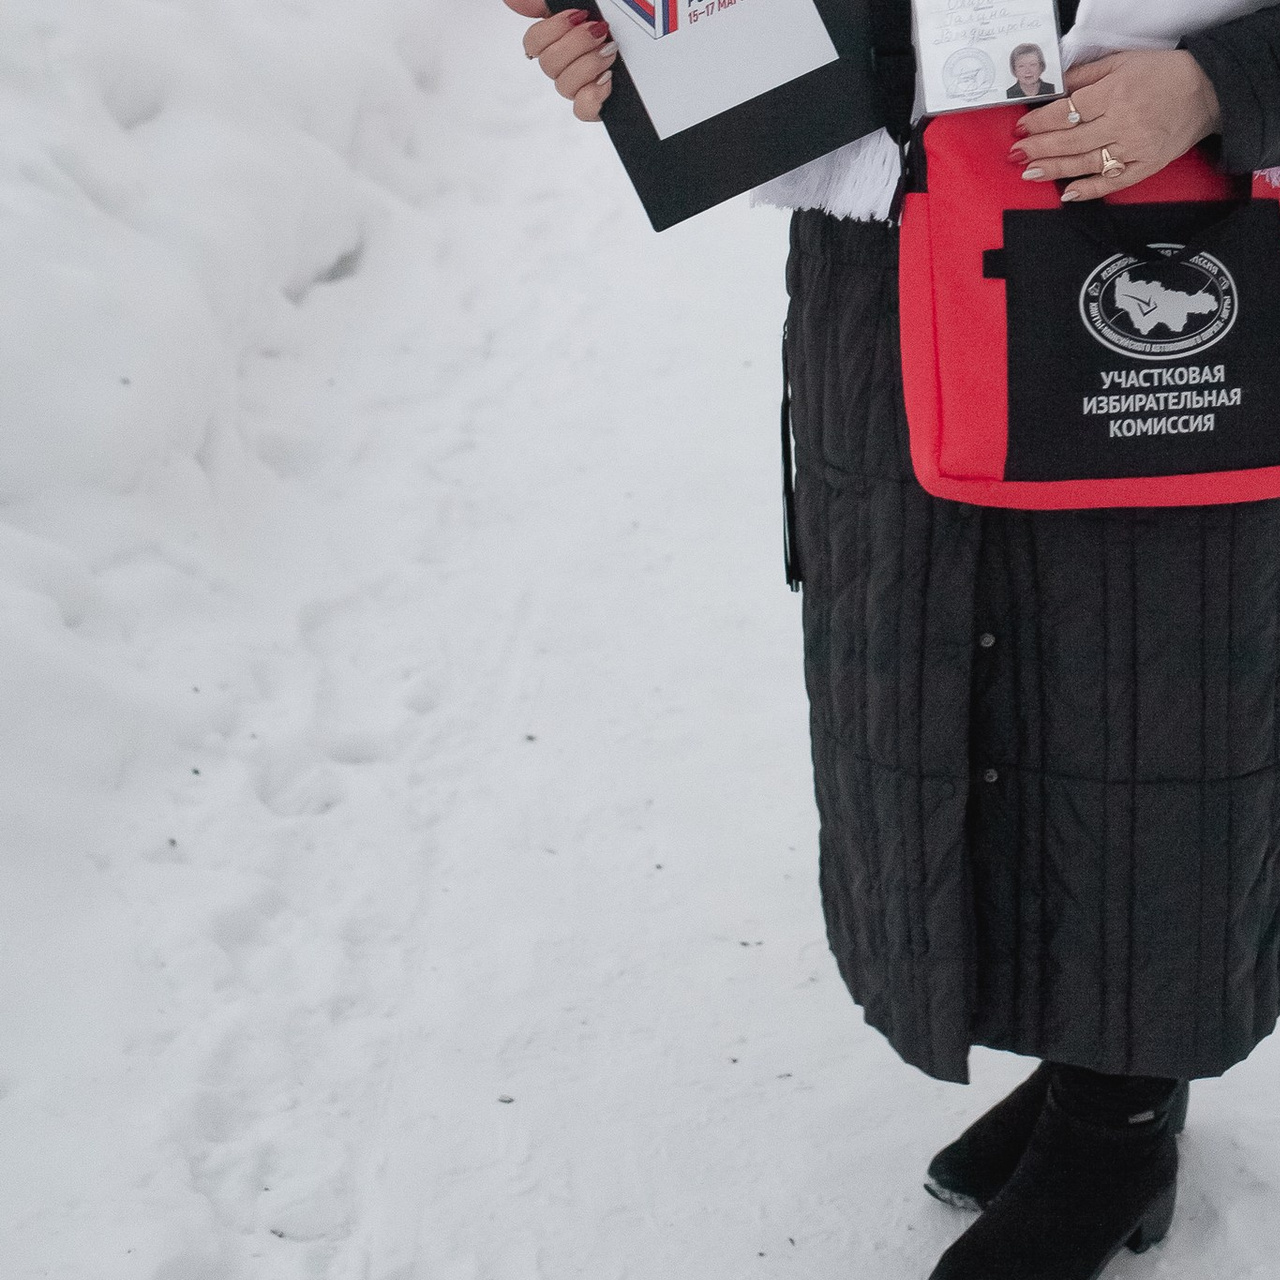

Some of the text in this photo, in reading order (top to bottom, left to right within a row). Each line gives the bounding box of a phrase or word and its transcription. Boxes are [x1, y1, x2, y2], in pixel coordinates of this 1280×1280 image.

[1101, 365, 1225, 389] УЧАСТКОВАЯ
[1083, 388, 1242, 415] ИЗБИРАТЕЛЬНАЯ
[1109, 414, 1215, 438] КОМИССИЯ
